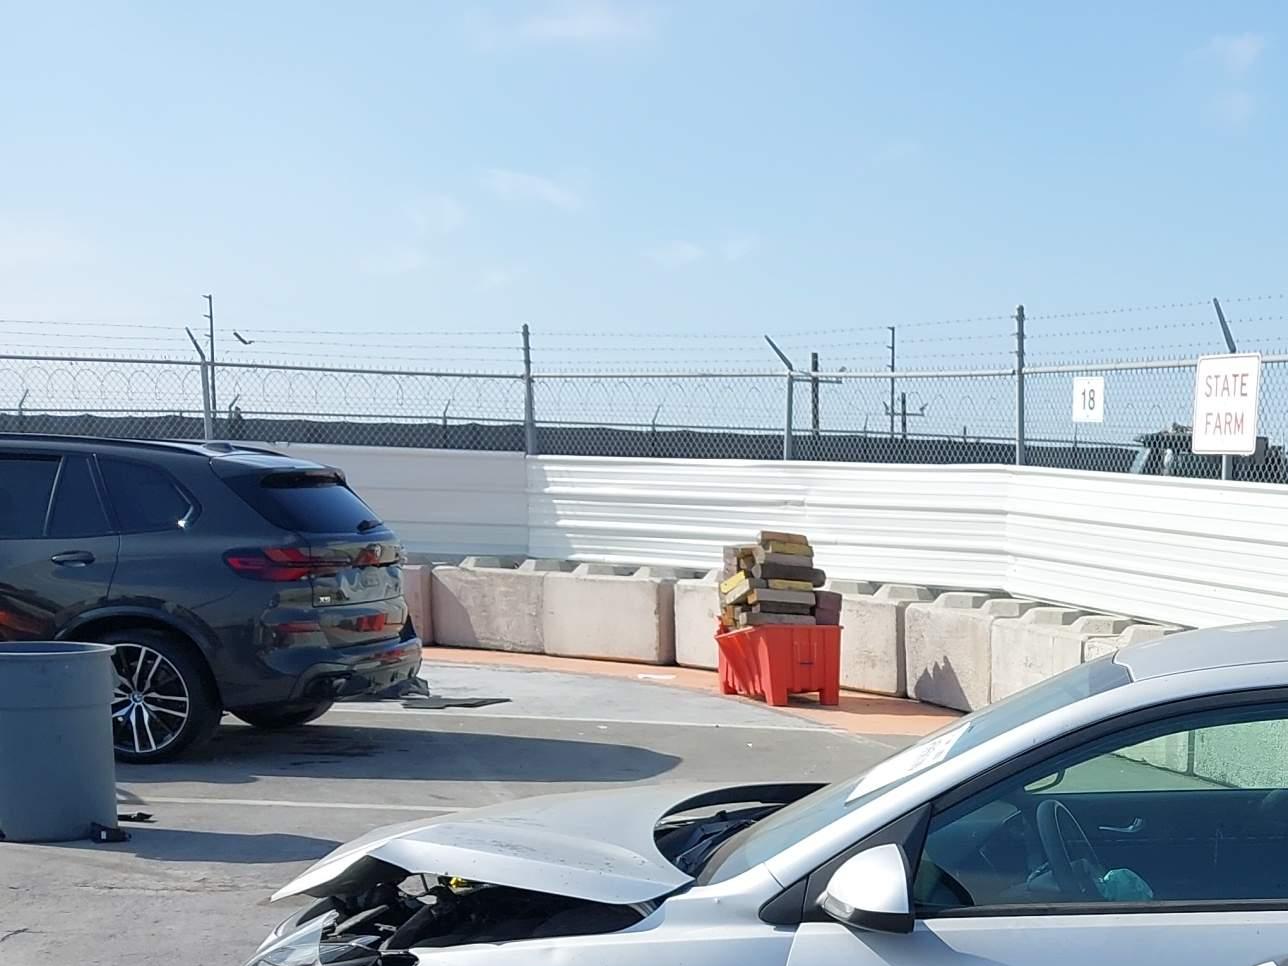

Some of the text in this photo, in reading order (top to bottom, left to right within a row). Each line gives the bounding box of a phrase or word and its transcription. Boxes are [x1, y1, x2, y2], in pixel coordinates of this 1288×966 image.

[1204, 373, 1248, 399] STATE
[1081, 388, 1095, 410] 18
[1204, 411, 1244, 436] FARM
